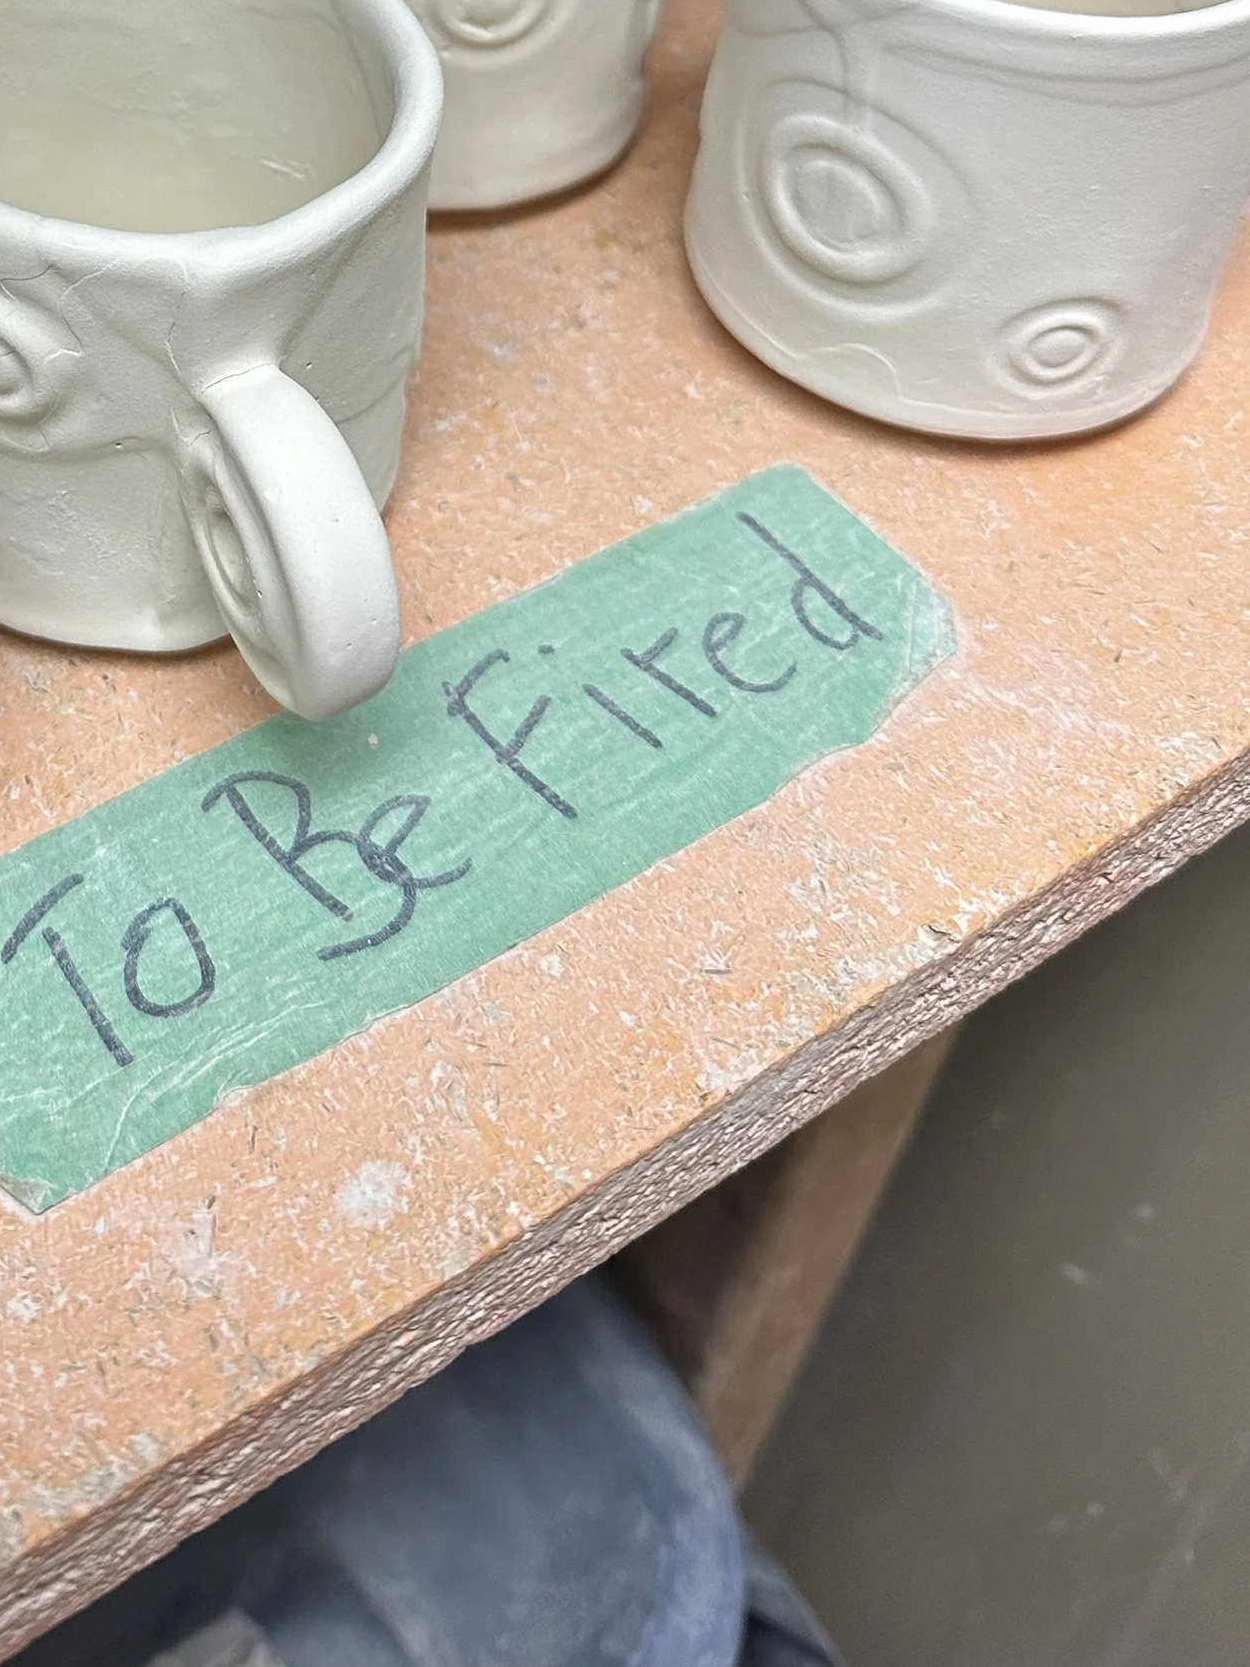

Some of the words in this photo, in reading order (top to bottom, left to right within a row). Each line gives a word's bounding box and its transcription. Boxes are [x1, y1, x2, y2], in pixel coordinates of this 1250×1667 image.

[1, 873, 218, 1066] To
[201, 769, 473, 961] Be
[442, 511, 884, 820] Fired
